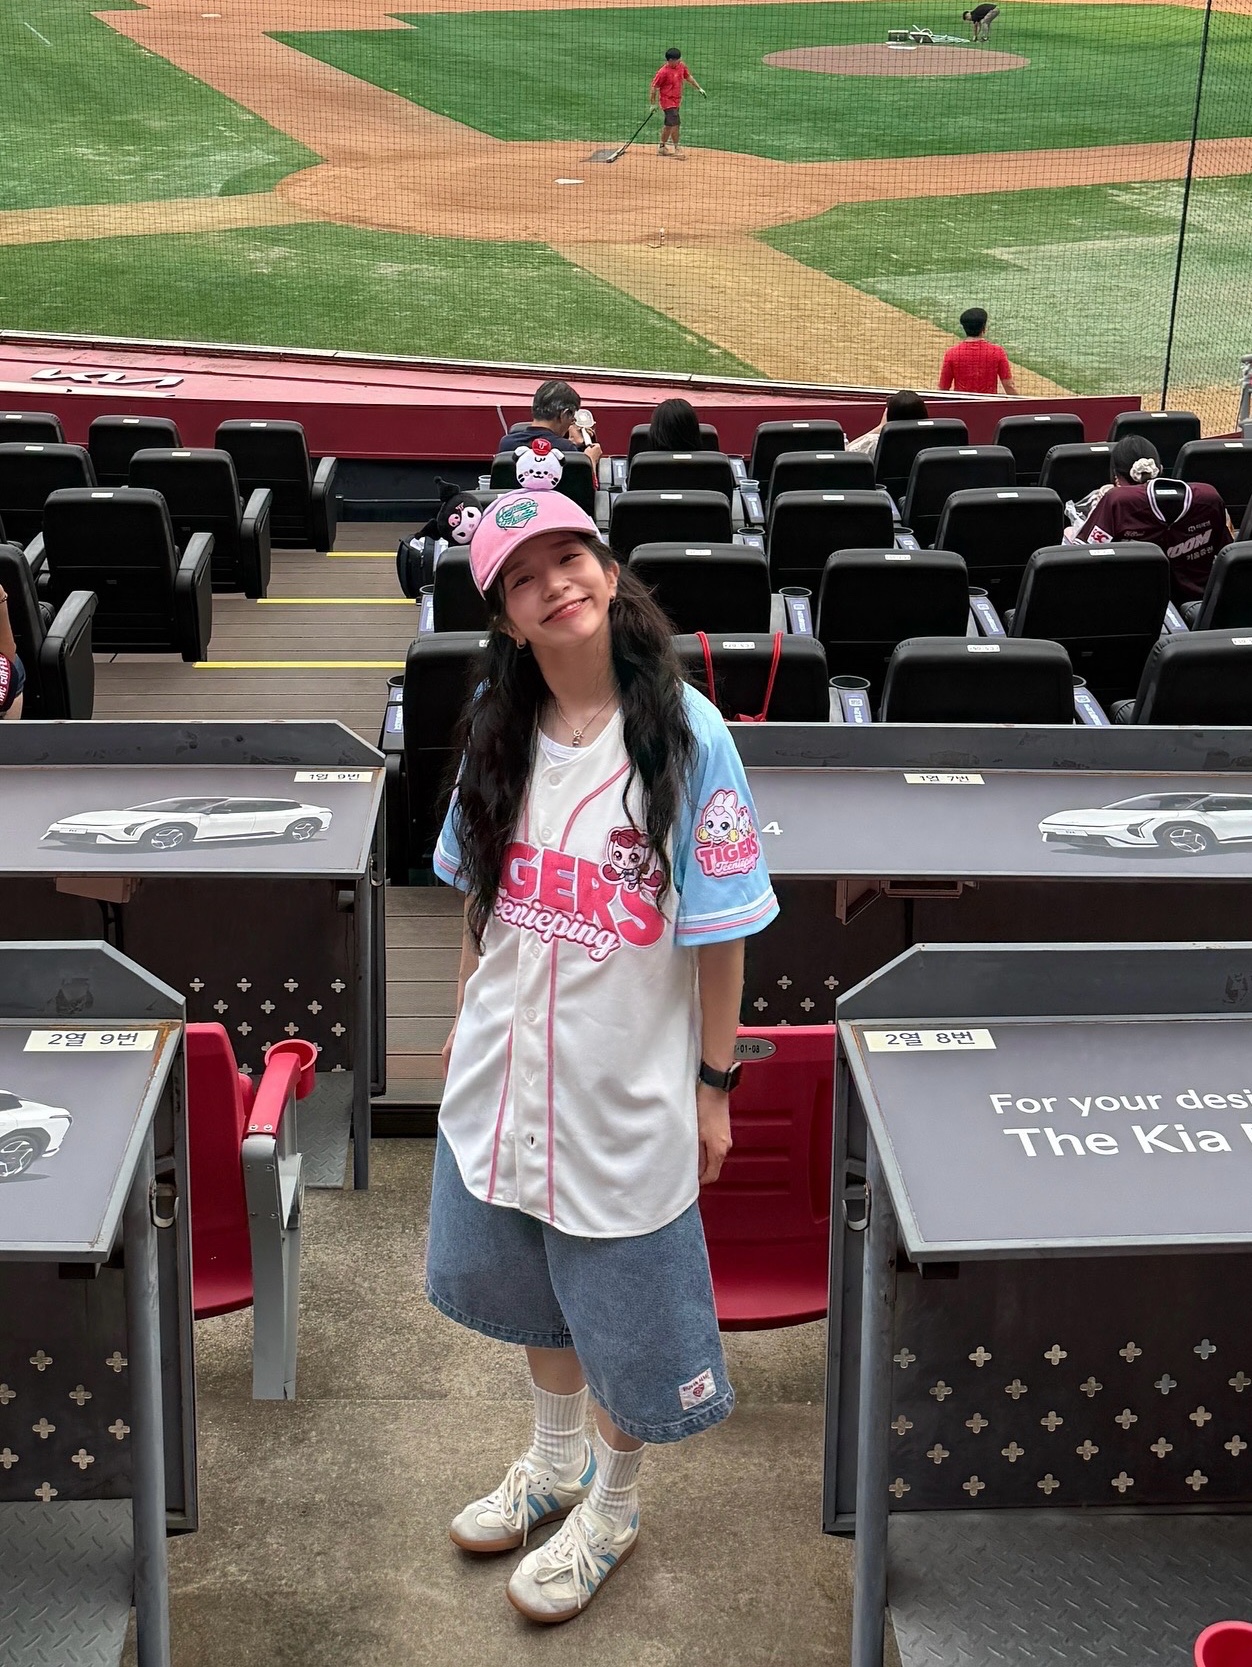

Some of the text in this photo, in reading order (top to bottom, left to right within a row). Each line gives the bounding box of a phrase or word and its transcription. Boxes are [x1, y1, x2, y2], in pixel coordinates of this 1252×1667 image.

[700, 833, 758, 872] TIGERS
[500, 841, 665, 947] GERS
[493, 887, 621, 961] eenieping
[47, 1032, 139, 1047] 2열 9번
[885, 1031, 976, 1047] 2열 8번
[989, 1093, 1058, 1114] For
[1068, 1094, 1162, 1117] your
[1003, 1127, 1120, 1157] The
[1131, 1123, 1232, 1154] Kia
